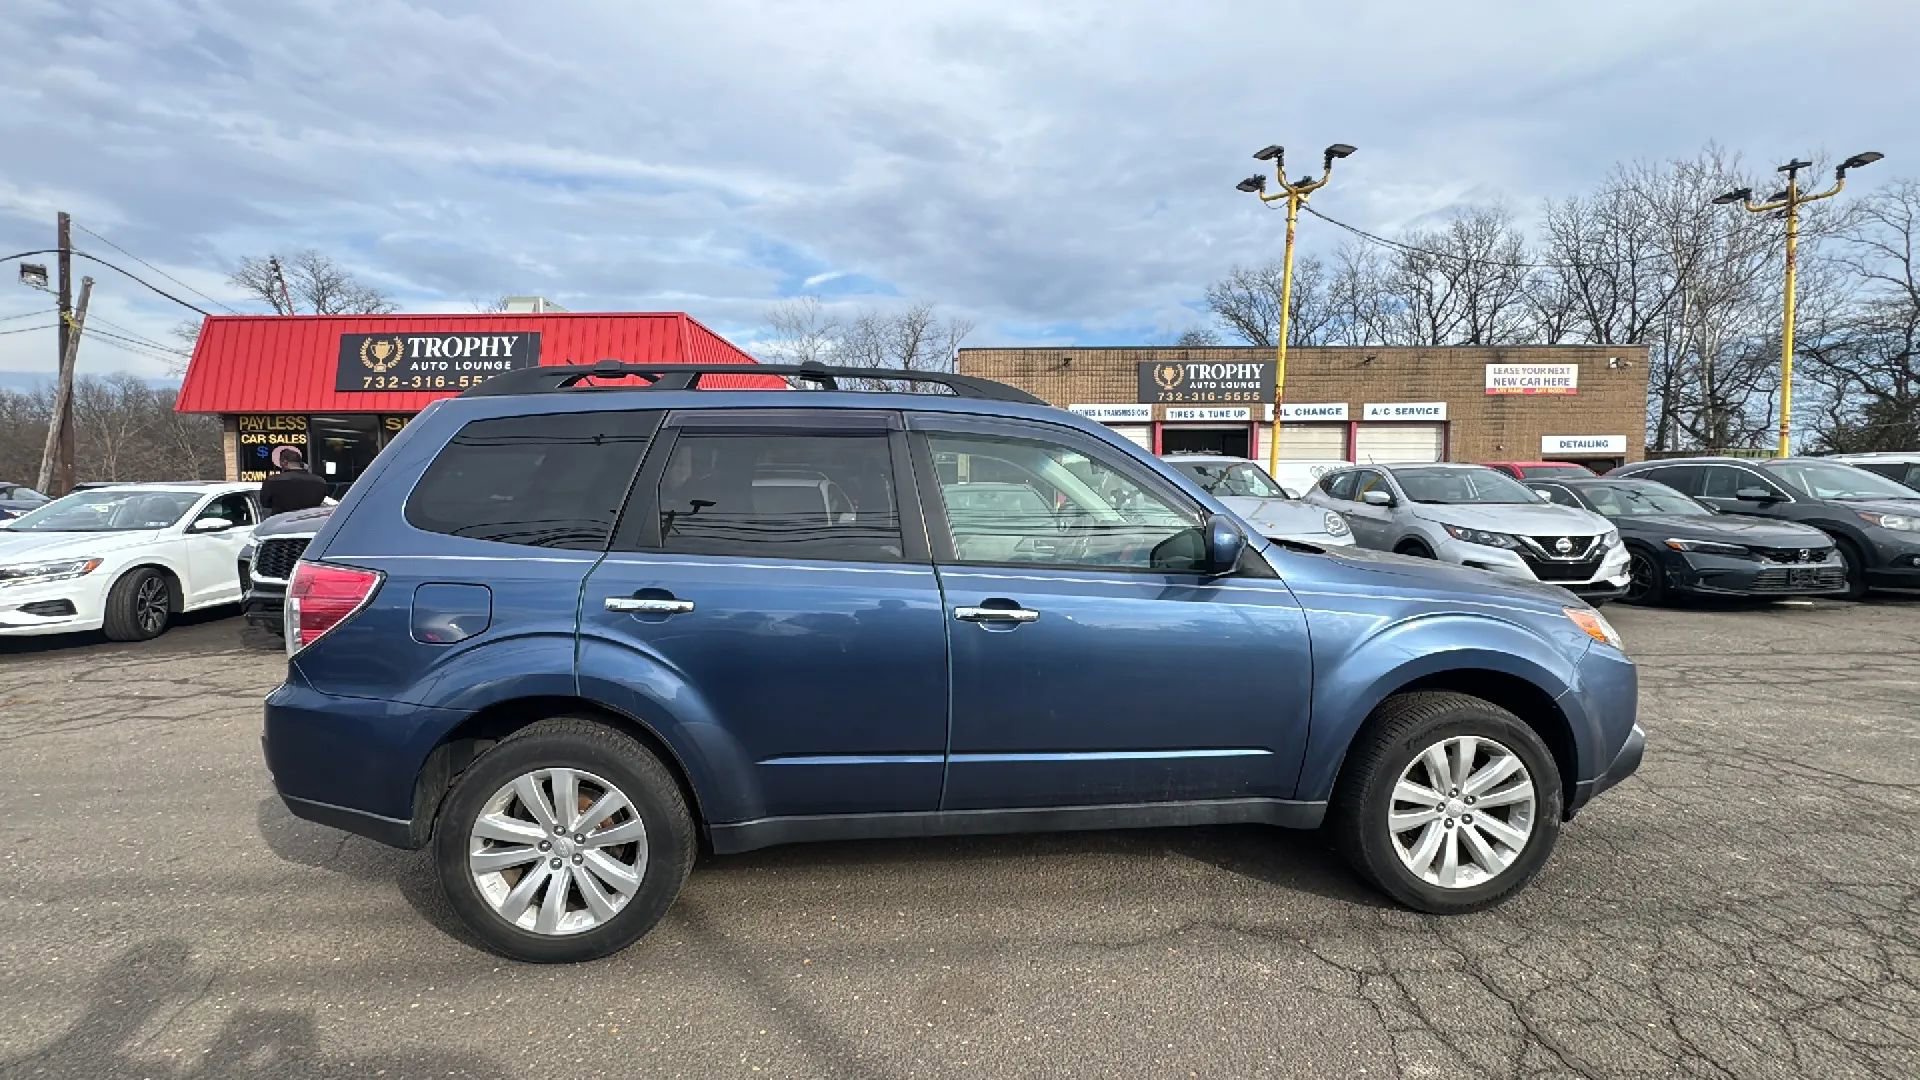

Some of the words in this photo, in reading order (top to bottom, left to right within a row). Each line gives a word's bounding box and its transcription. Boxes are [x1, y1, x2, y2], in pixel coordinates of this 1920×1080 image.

[407, 335, 519, 358] TROPHY
[409, 361, 449, 371] AUTO
[455, 361, 512, 371] LOUNGE
[1185, 363, 1265, 379] TROPHY
[1493, 367, 1520, 375] LEASE
[1522, 367, 1546, 375] YOUR
[1548, 367, 1571, 375] NEXT
[1190, 381, 1217, 389] AUTO
[1221, 381, 1261, 389] LOUNGE
[1493, 377, 1518, 386] NEW
[1519, 377, 1541, 386] CAR
[1543, 377, 1571, 386] HERE
[1157, 391, 1261, 401] 732-316-5555
[1169, 410, 1195, 418] TIRES
[1198, 410, 1205, 418] &
[1207, 410, 1231, 418] TUNE
[1234, 410, 1247, 418] UP
[1295, 407, 1343, 416] CHANGE
[1371, 407, 1391, 416] A/C
[1395, 407, 1441, 416] SERVICE
[239, 416, 307, 430] PAYLESS
[241, 434, 267, 444] CAR
[268, 434, 307, 444] SALES
[1559, 440, 1609, 448] DETAILING
[241, 471, 267, 482] DOWN
